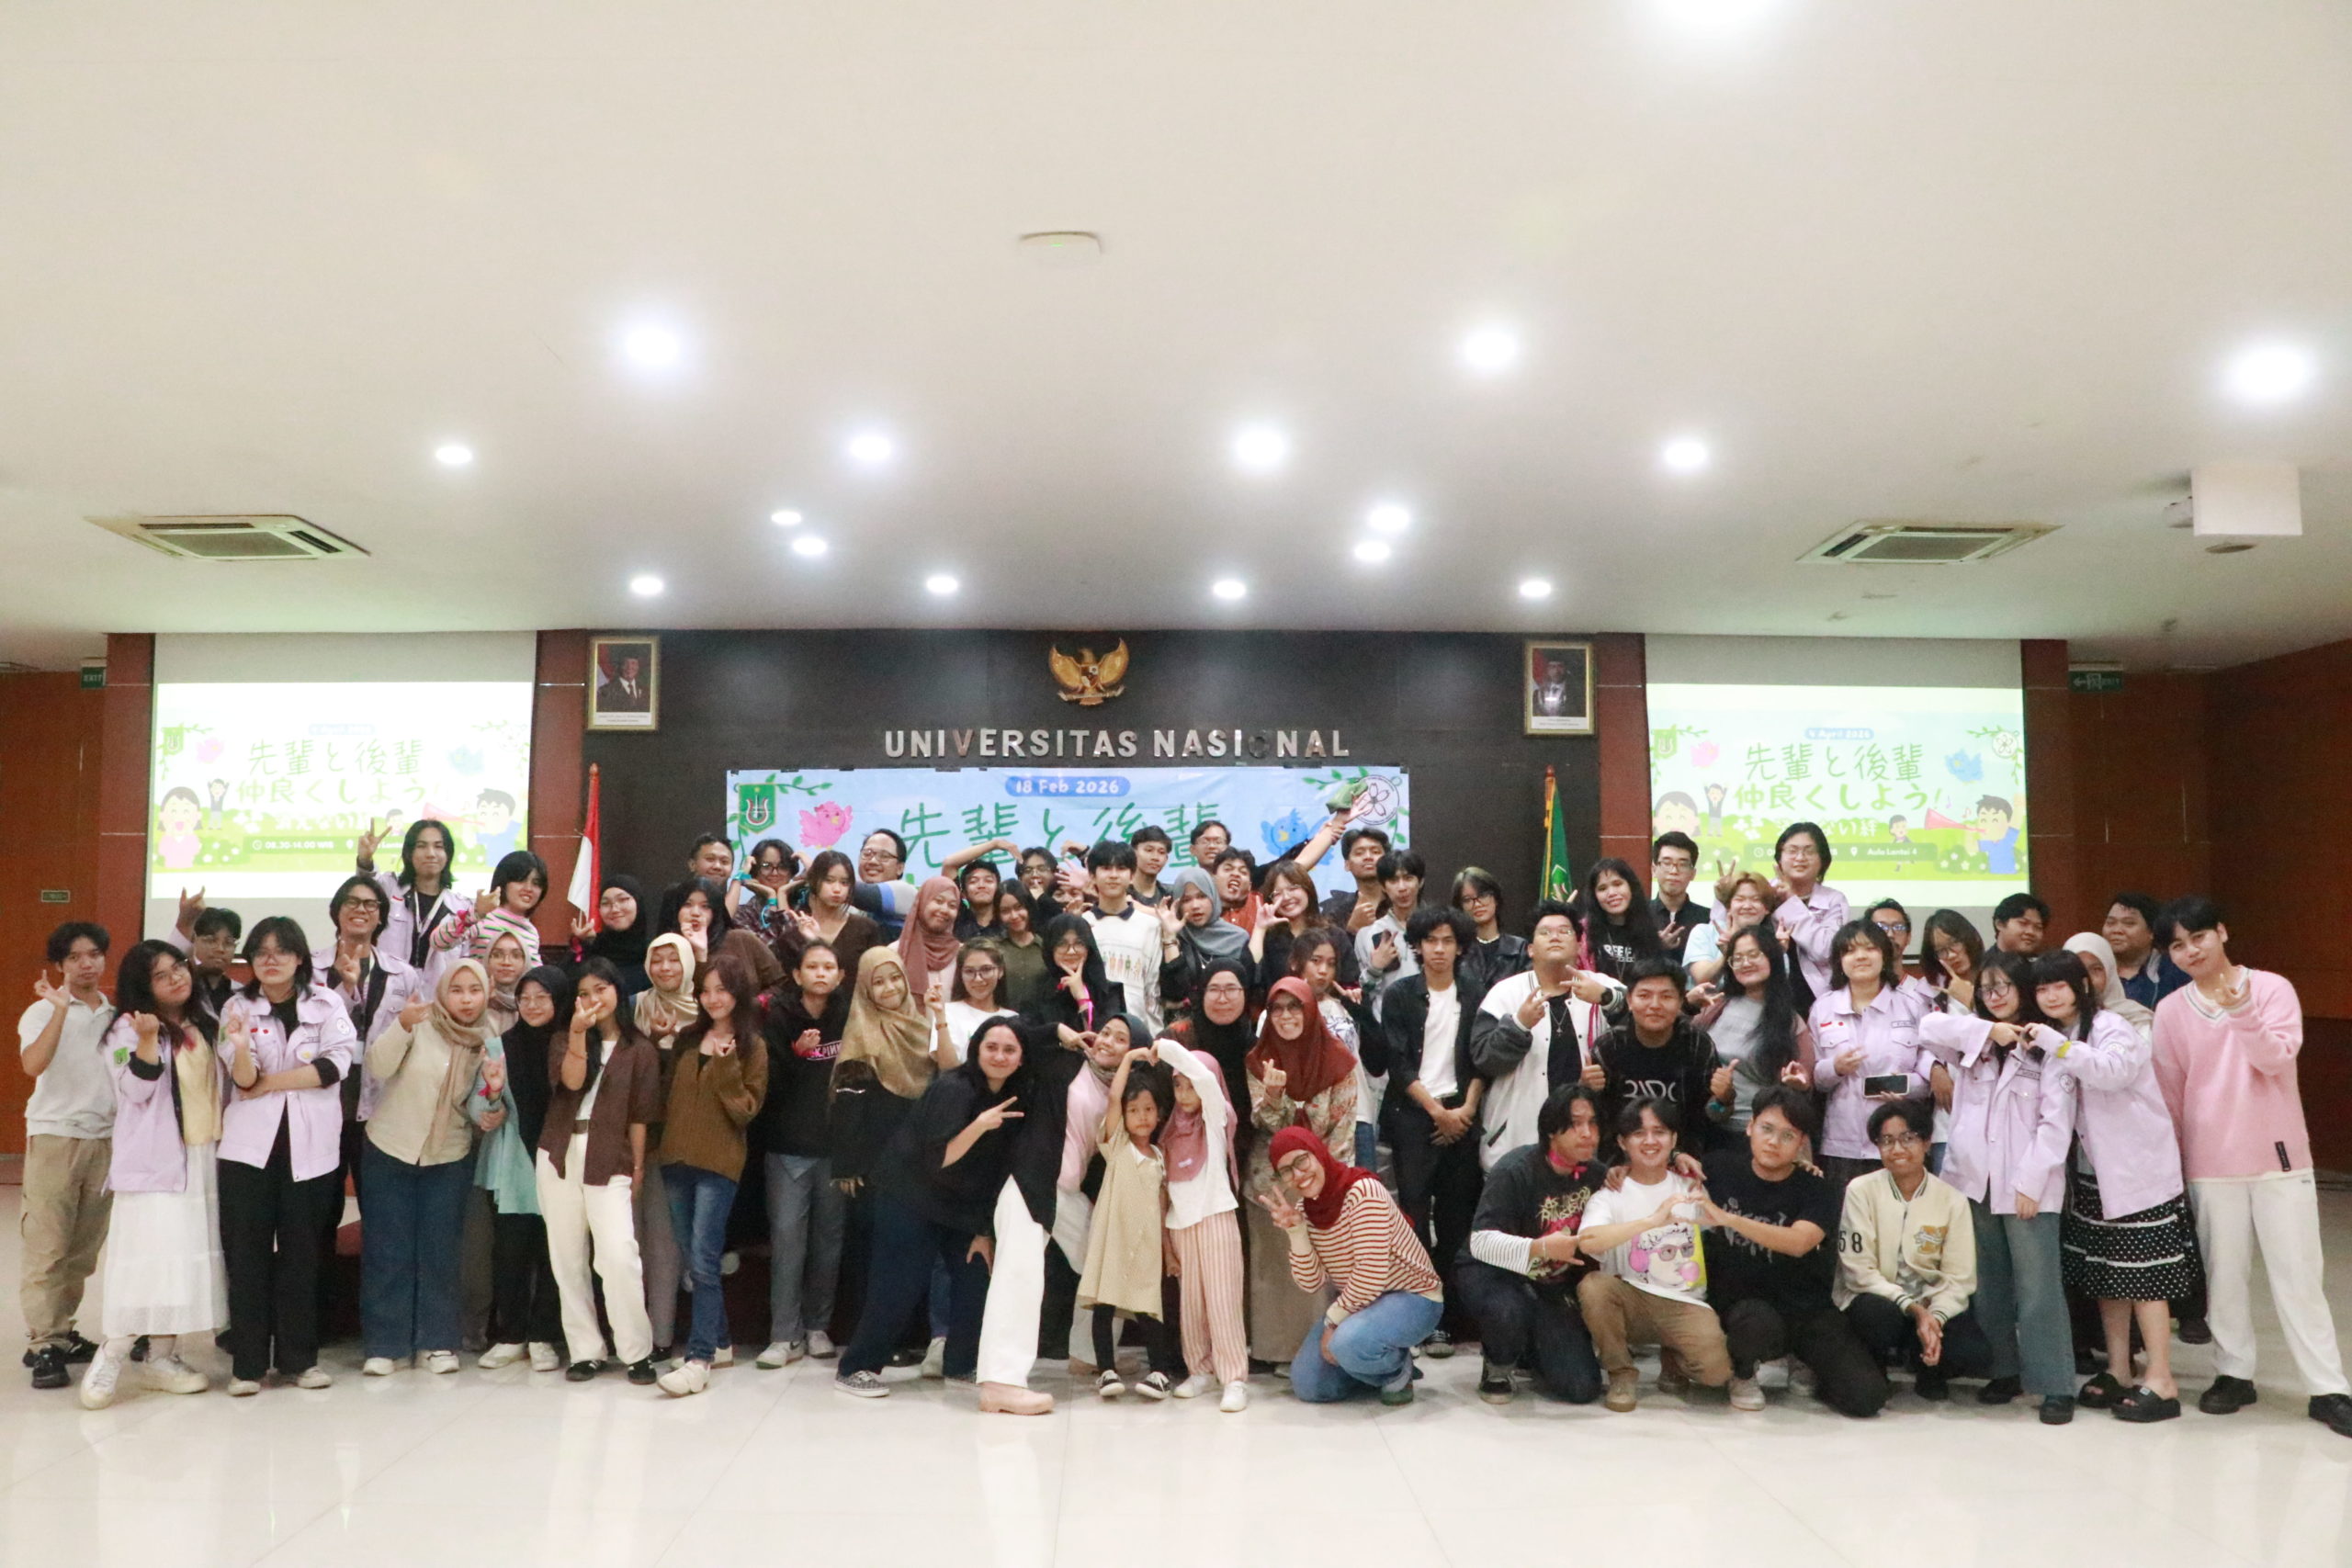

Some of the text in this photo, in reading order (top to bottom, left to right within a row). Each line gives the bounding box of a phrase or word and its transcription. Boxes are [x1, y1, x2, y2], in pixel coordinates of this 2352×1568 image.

[248, 739, 424, 776] 先輩と後輩
[885, 728, 1350, 758] UNIVERSITAS NASIONAL
[1745, 742, 1924, 782] 先輩と後輩
[1015, 779, 1119, 794] 18 Feb 2026
